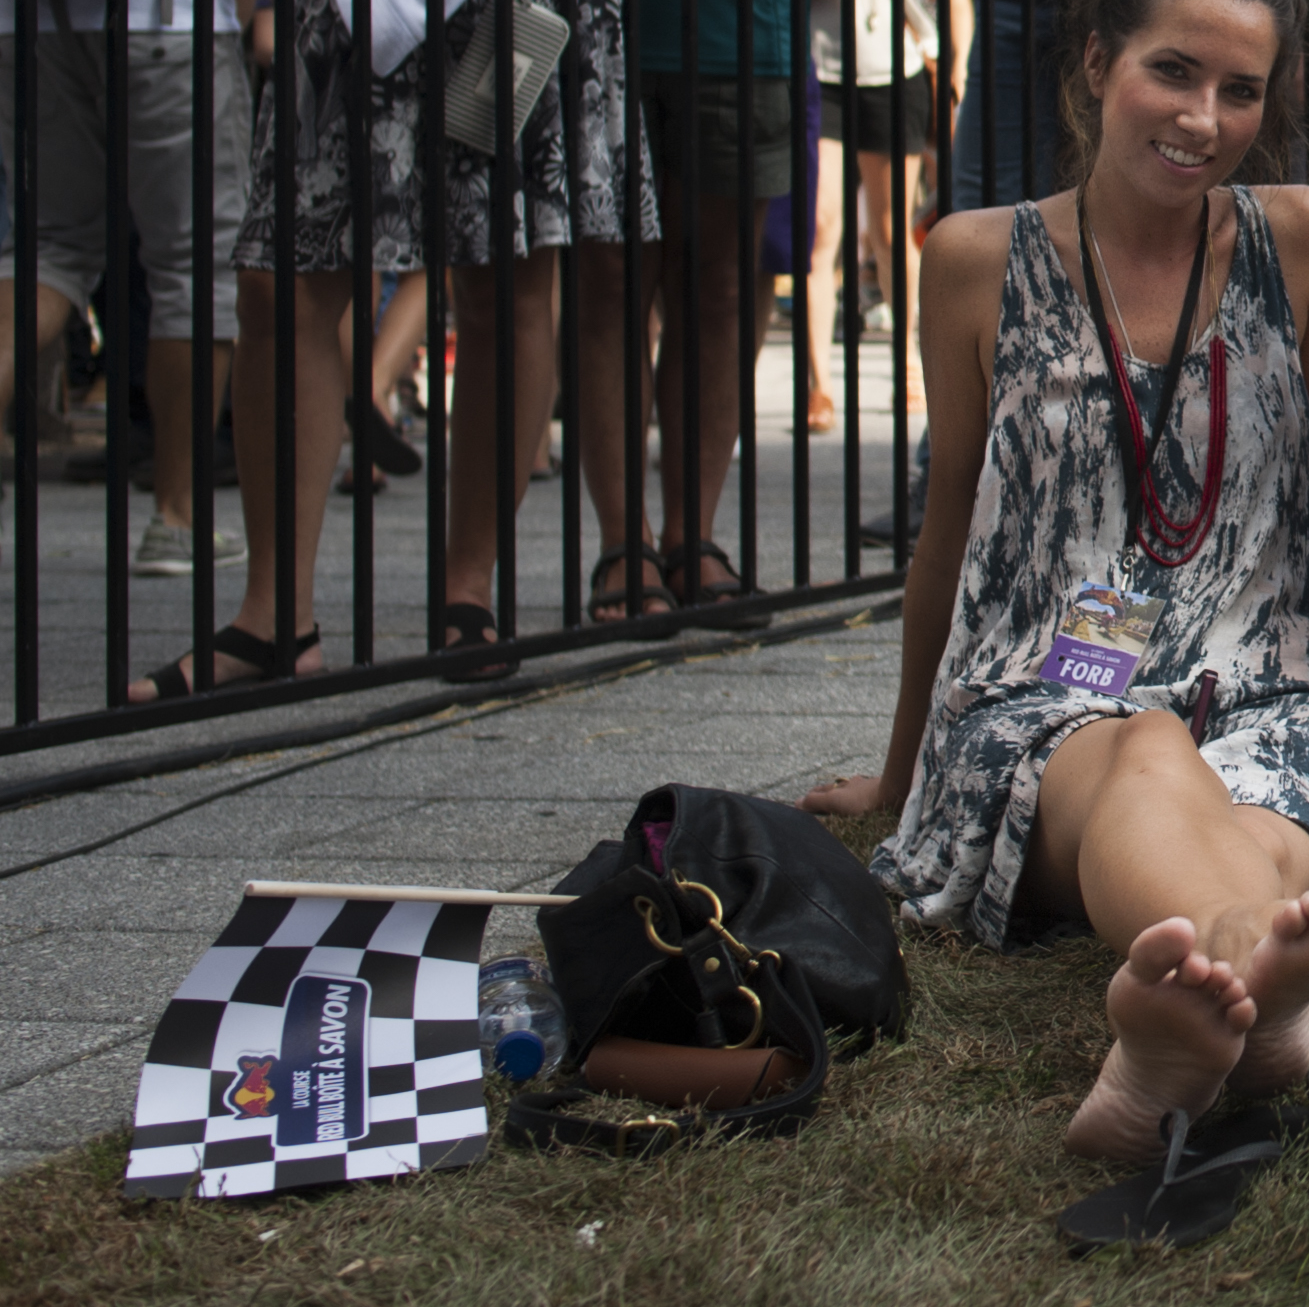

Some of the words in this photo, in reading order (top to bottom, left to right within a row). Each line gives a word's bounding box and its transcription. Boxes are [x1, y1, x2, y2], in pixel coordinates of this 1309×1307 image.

[1059, 658, 1115, 687] FORB
[318, 984, 351, 1054] SAVON
[311, 1057, 345, 1069] À
[292, 1070, 310, 1099] COURSE
[292, 1099, 310, 1109] LA
[317, 1101, 345, 1123] BULL
[316, 1122, 345, 1142] RED
